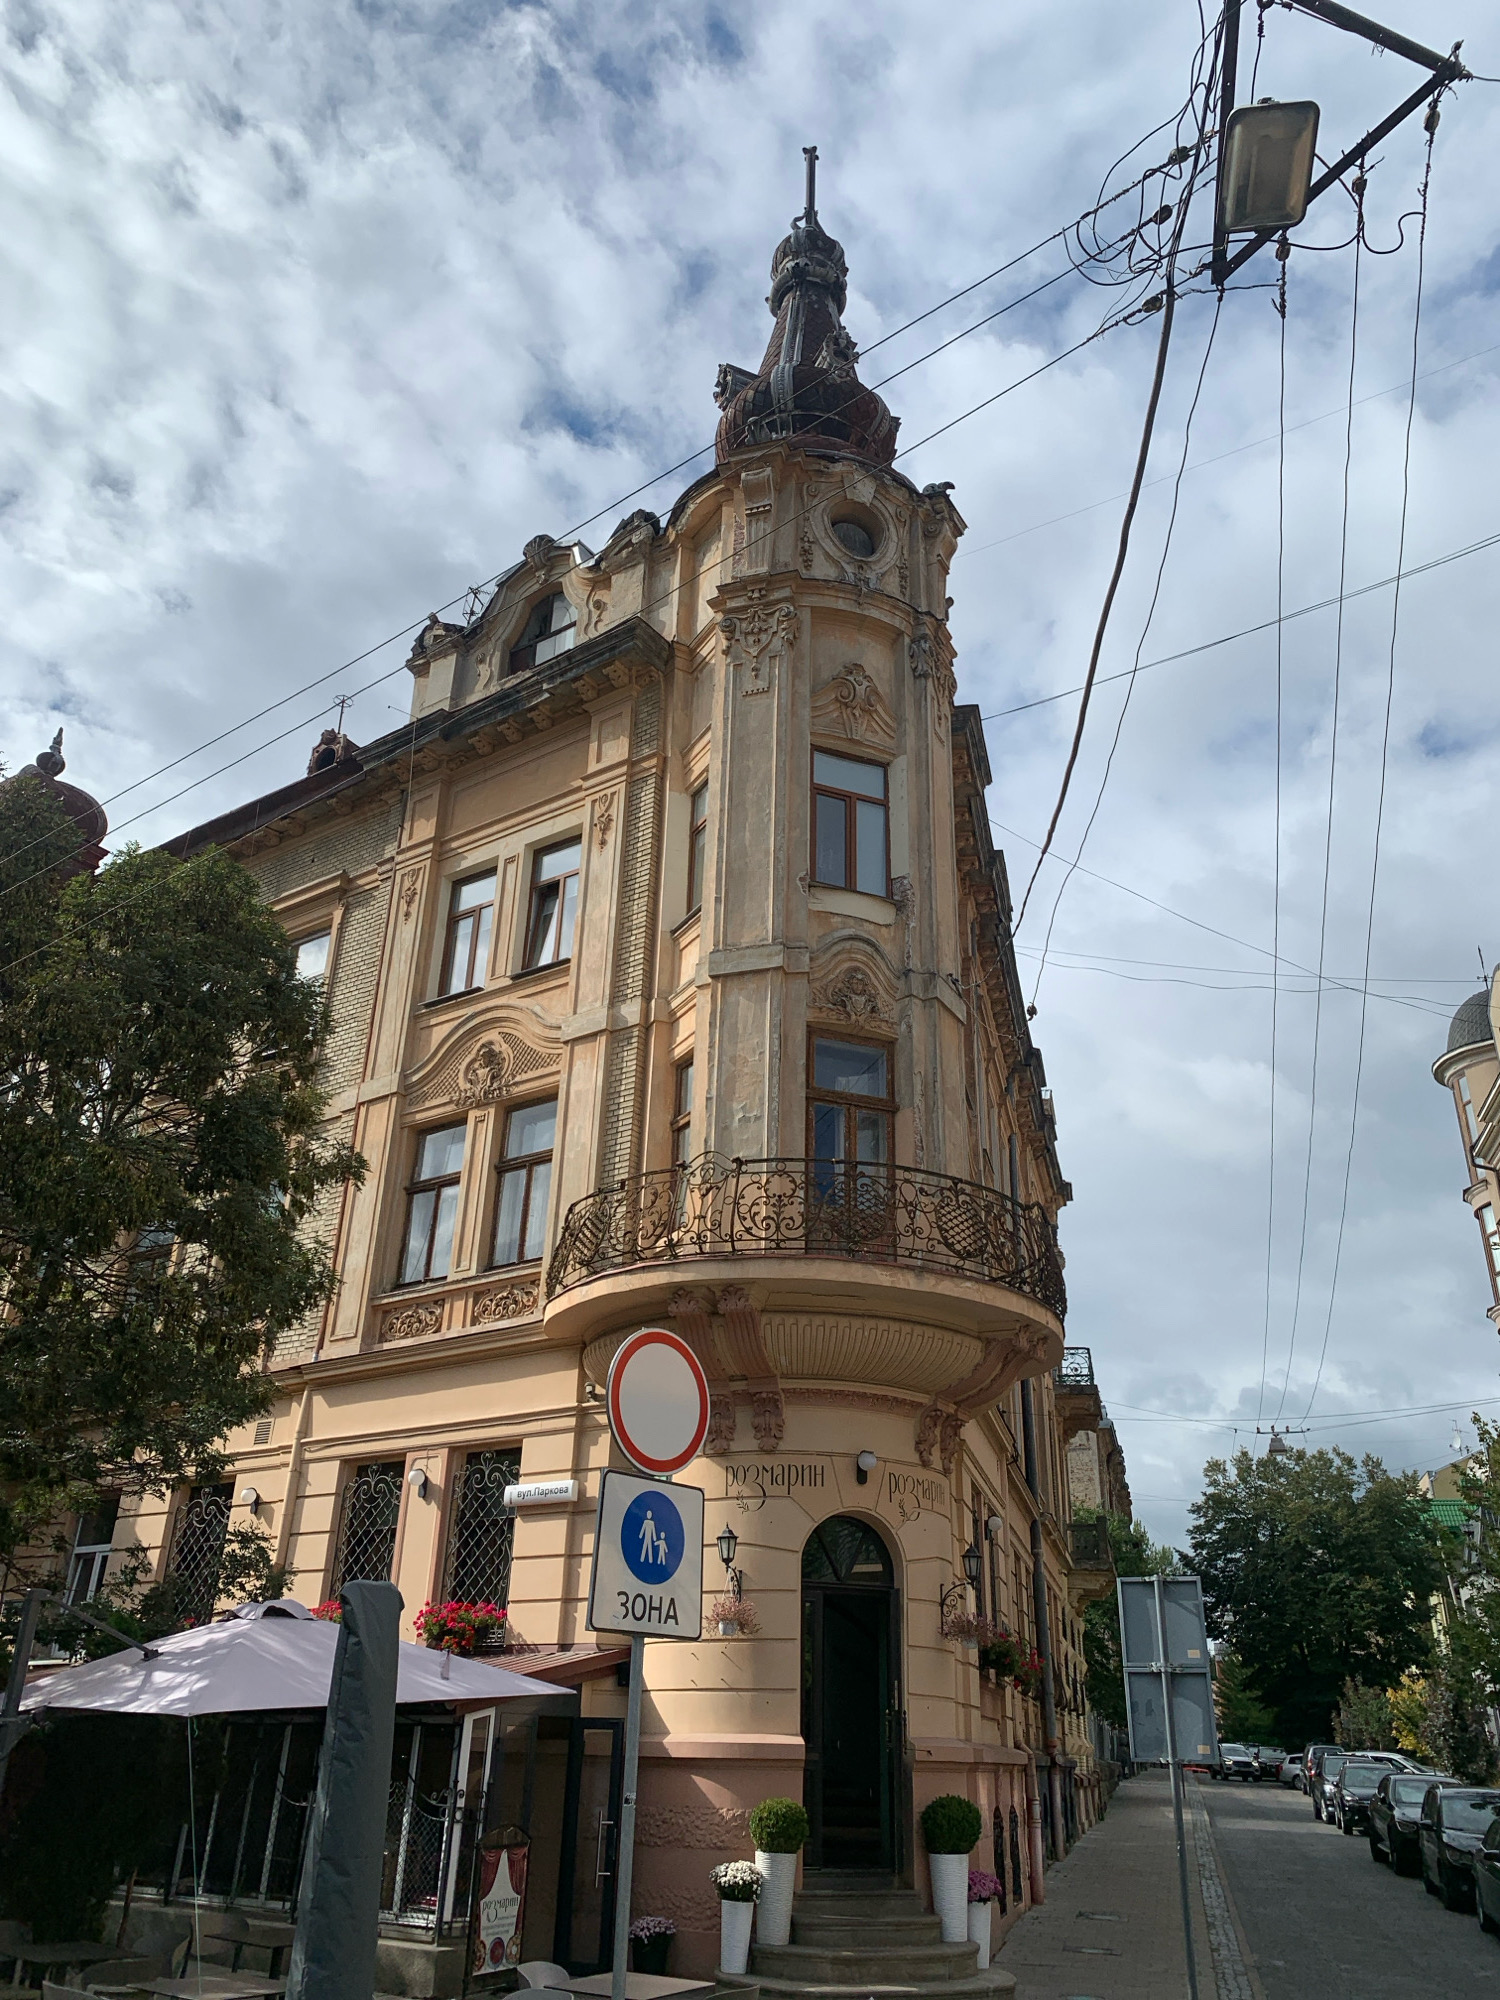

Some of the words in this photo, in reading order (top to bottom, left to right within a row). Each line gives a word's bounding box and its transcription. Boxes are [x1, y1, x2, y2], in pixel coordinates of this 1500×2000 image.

[517, 1486, 569, 1499] вул.Паркова
[725, 1463, 824, 1512] розмарин
[616, 1590, 679, 1625] ЗОНА
